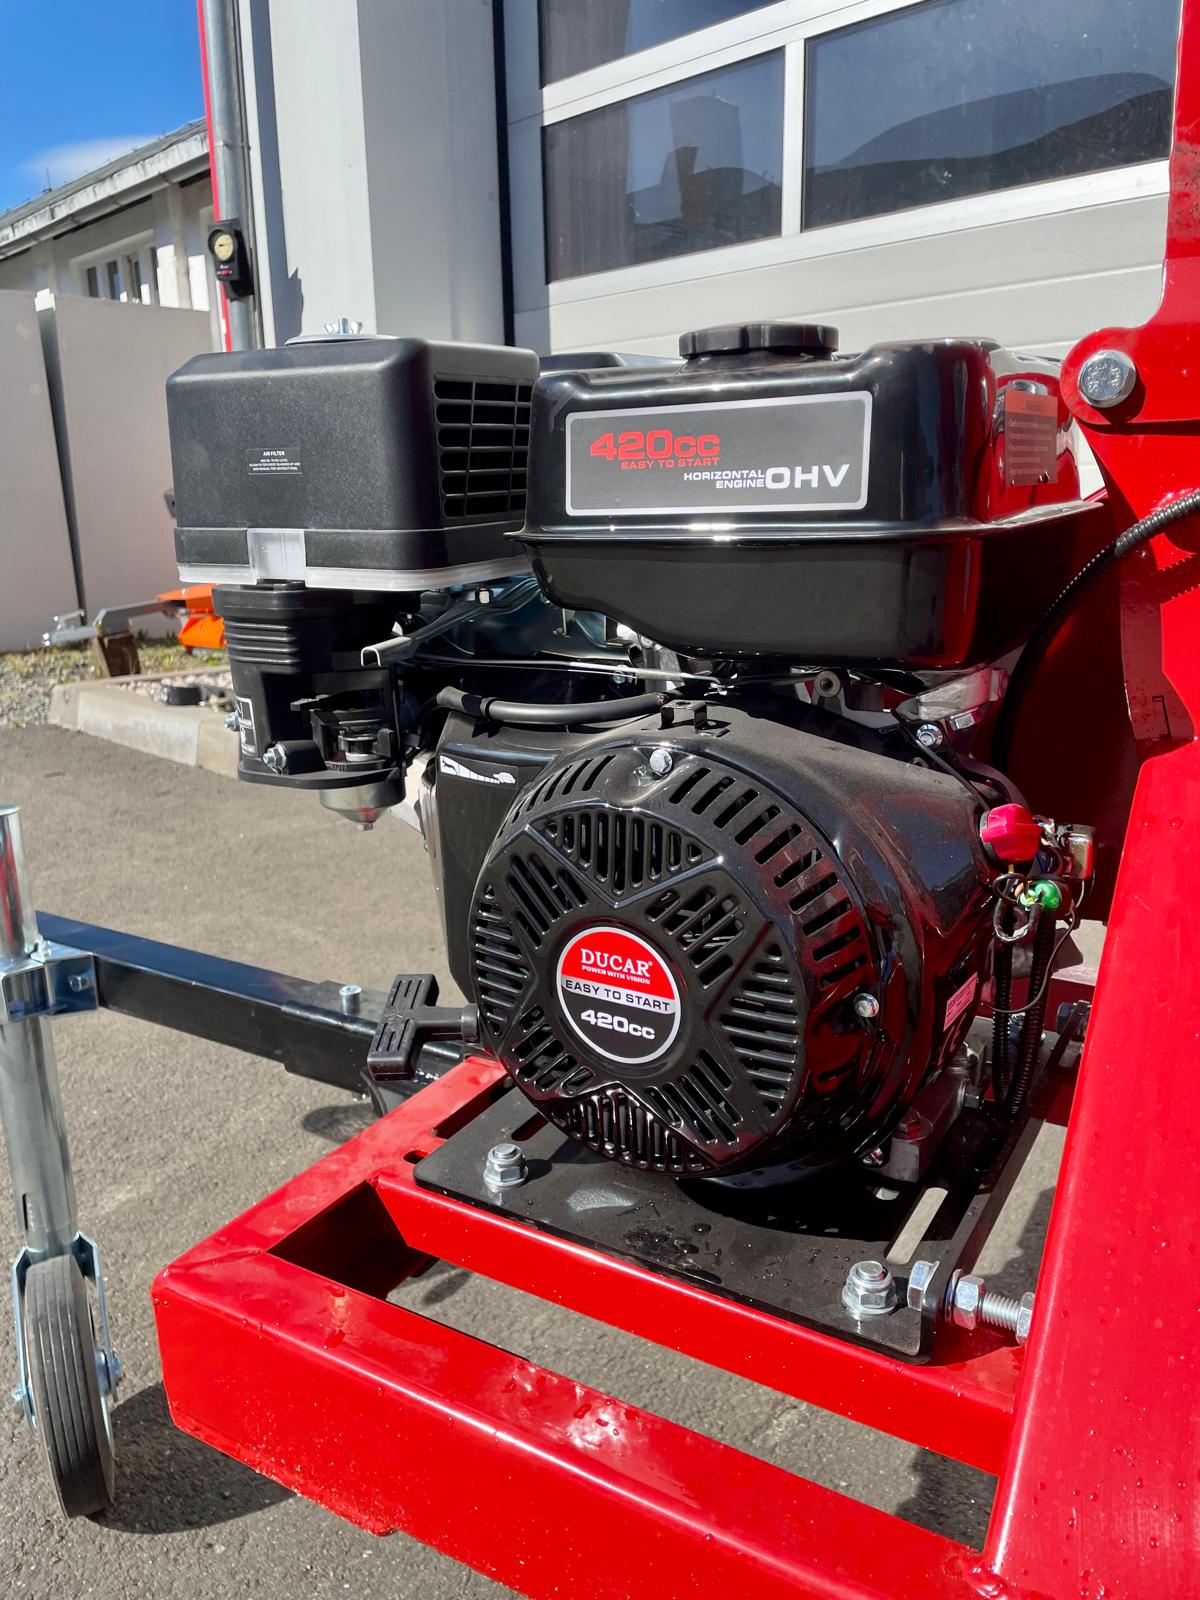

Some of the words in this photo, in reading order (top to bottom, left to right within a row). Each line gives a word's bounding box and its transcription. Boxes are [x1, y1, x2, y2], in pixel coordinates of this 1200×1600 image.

[590, 429, 720, 460] 420cc
[620, 461, 654, 470] EASY
[657, 459, 675, 468] TO
[677, 457, 720, 468] START
[683, 469, 765, 481] HORIZONTAL
[765, 463, 850, 490] OHV
[715, 478, 765, 489] ENGINE
[582, 965, 606, 975] POWER
[607, 971, 625, 979] WITH
[626, 975, 650, 984] VISION
[565, 980, 599, 995] EASY
[604, 988, 621, 999] TO
[625, 994, 670, 1011] START
[581, 1009, 655, 1039] 420cc
